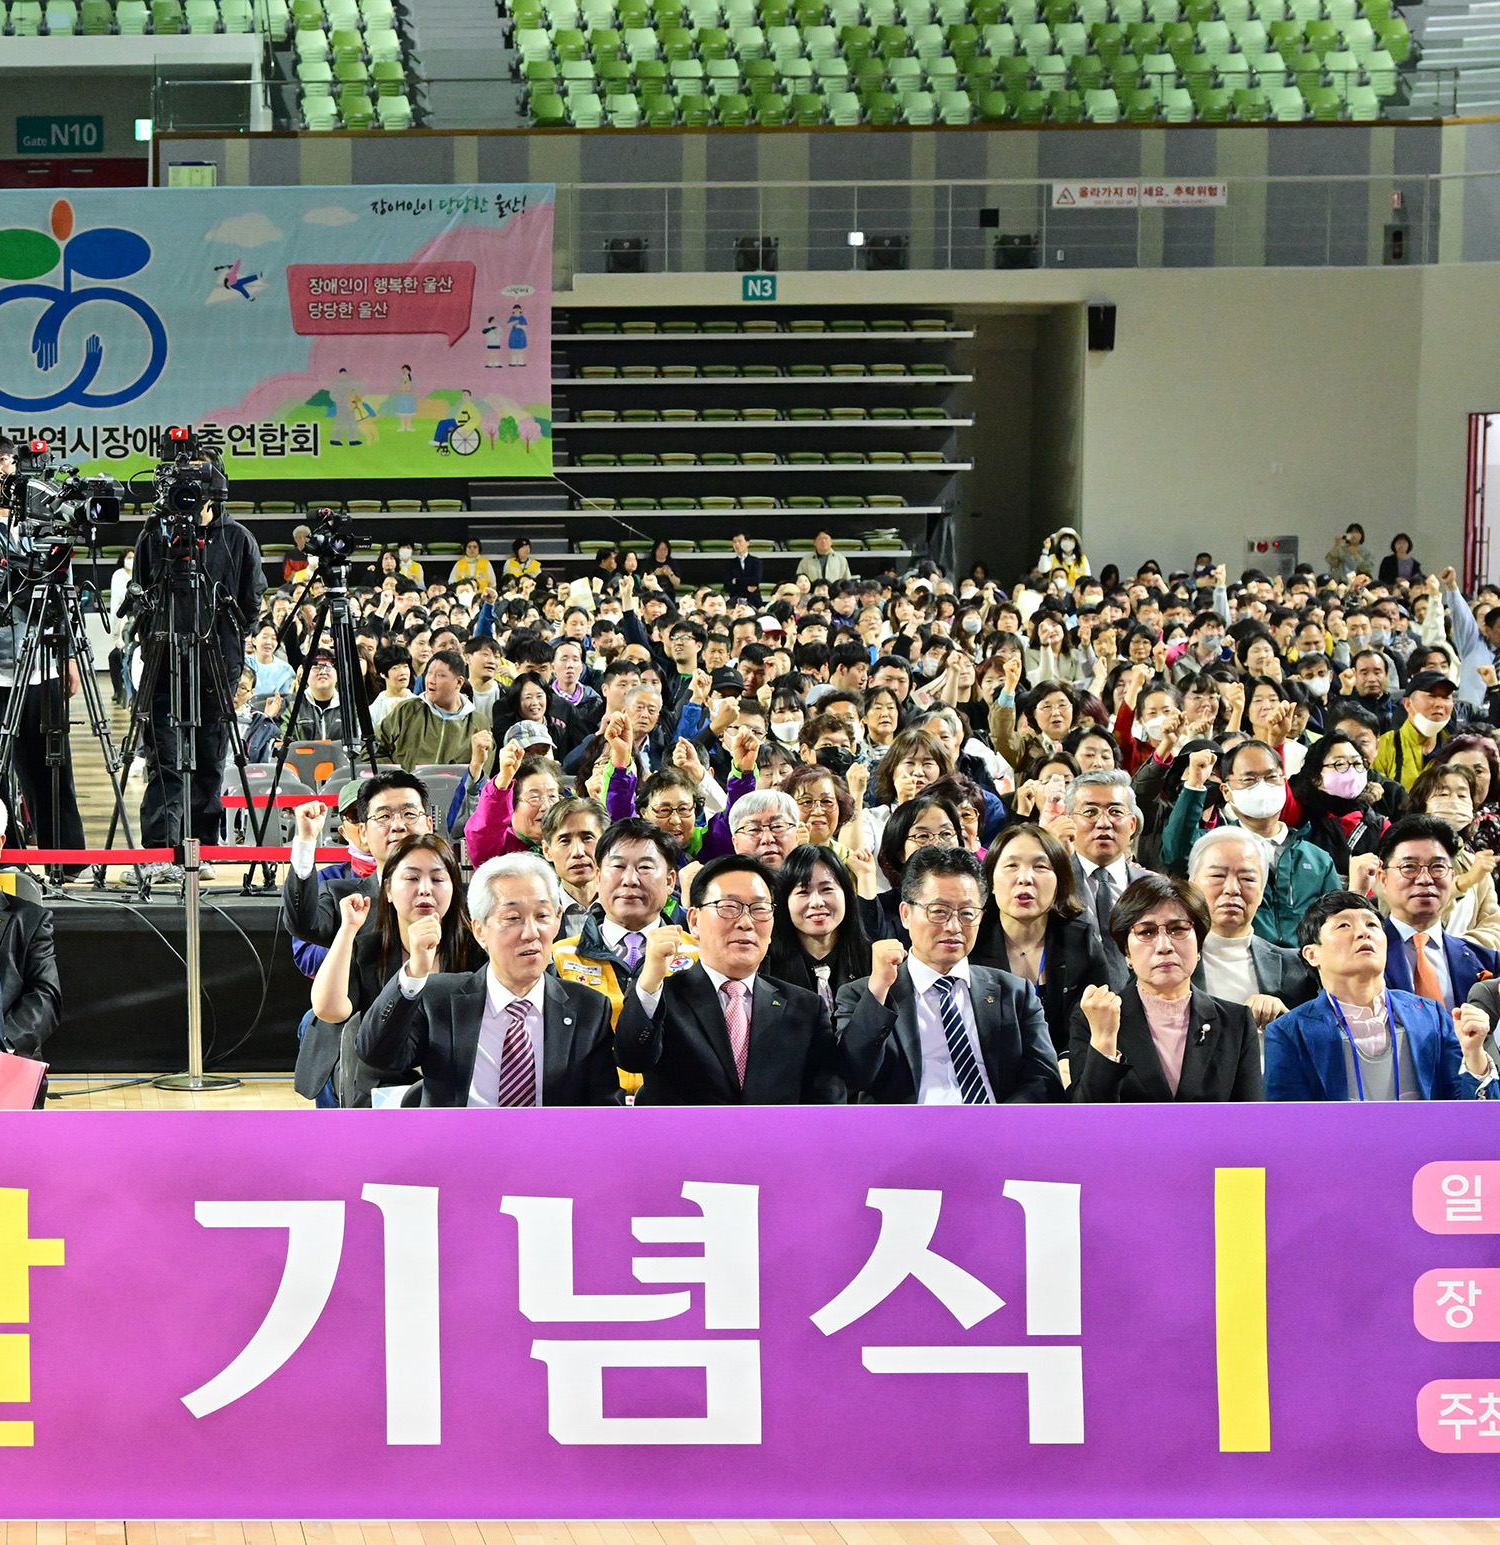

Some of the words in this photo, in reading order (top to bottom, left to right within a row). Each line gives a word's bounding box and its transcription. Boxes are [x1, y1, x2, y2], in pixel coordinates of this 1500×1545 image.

[22, 136, 48, 147] Gate
[50, 122, 98, 147] N10
[370, 198, 433, 216] 장애인이
[439, 196, 489, 215] 당당한
[494, 193, 527, 219] 울산!
[308, 277, 368, 295] 장애인이
[373, 276, 419, 294] 행복한
[423, 275, 453, 293] 울산
[748, 279, 773, 297] N3
[308, 302, 353, 320] 당당한
[358, 301, 388, 319] 울산
[1441, 1174, 1482, 1222] 일
[180, 1180, 1085, 1446] 기념식
[1435, 1280, 1482, 1329] 장
